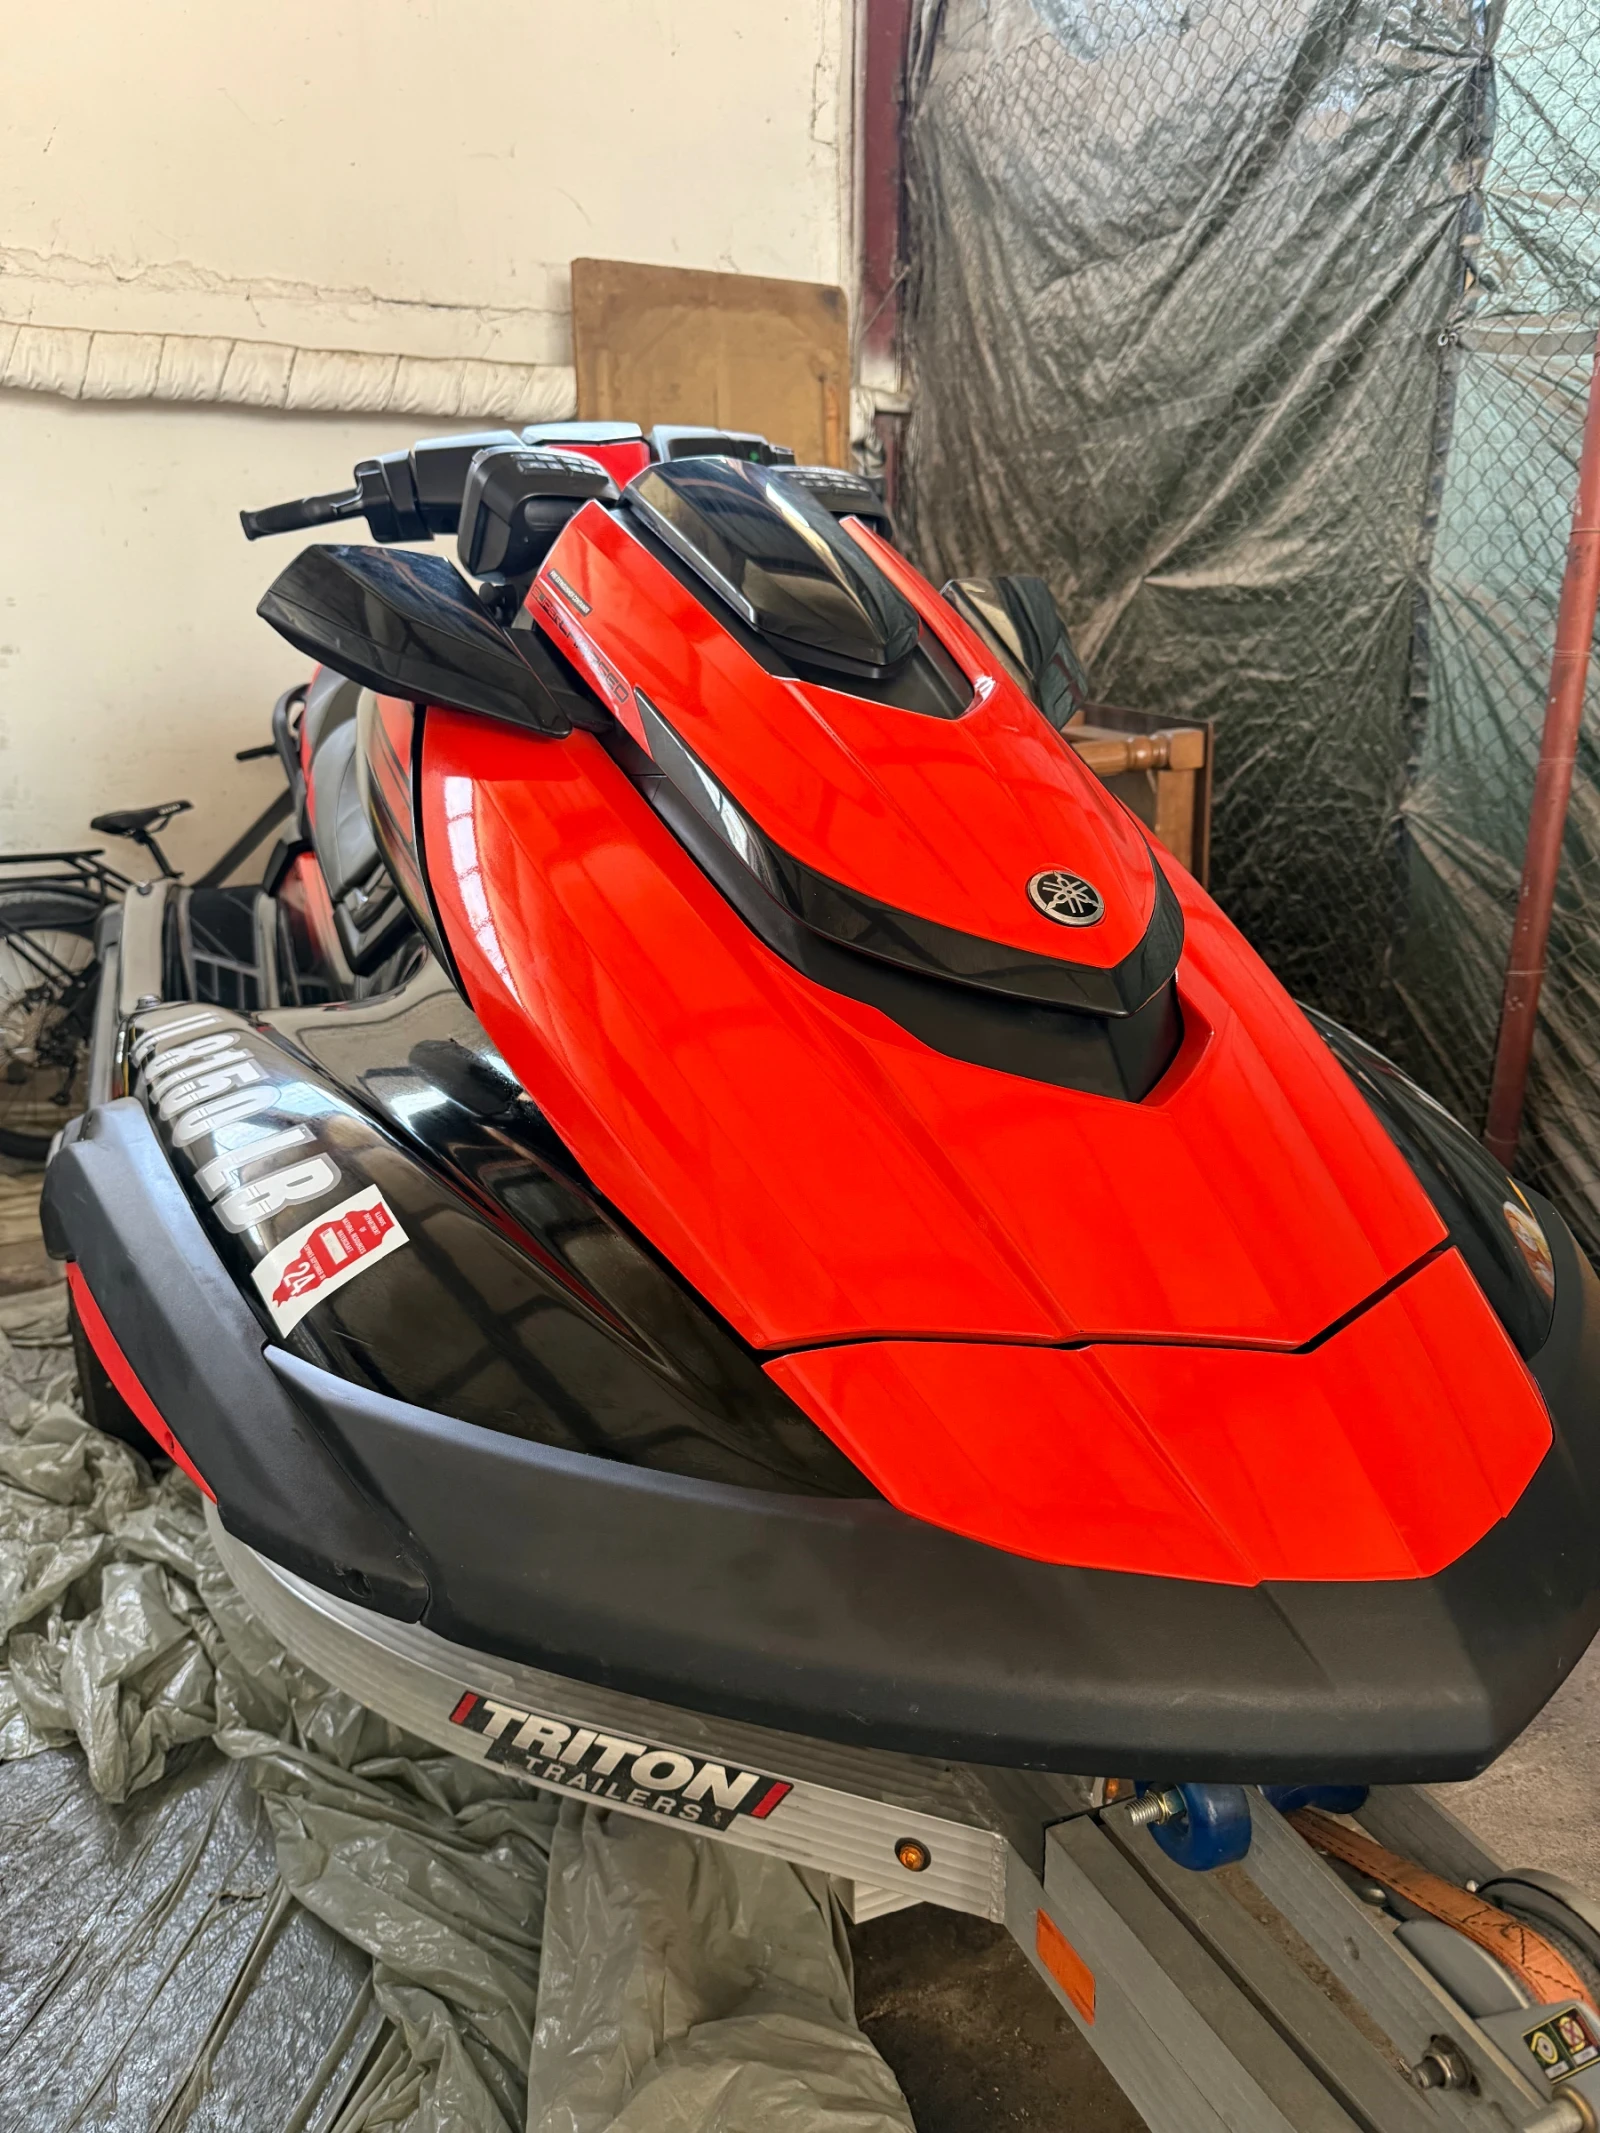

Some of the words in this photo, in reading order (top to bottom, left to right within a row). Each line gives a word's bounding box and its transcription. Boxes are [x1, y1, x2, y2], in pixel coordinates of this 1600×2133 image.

[131, 1010, 222, 1066] IL
[142, 1030, 281, 1148] 8150
[194, 1122, 342, 1234] LB
[341, 1217, 354, 1233] NATURAL
[350, 1232, 366, 1254] RESOURCES
[362, 1213, 380, 1235] DEPARTMENT
[374, 1211, 386, 1226] ILLINOIS
[303, 1244, 314, 1258] EXPIRES
[310, 1256, 324, 1275] SEPTEMBER
[336, 1229, 353, 1253] WATERCRAFT
[282, 1261, 316, 1296] 24
[482, 1700, 760, 1810] TRITON
[526, 1756, 703, 1822] TRAILERS
